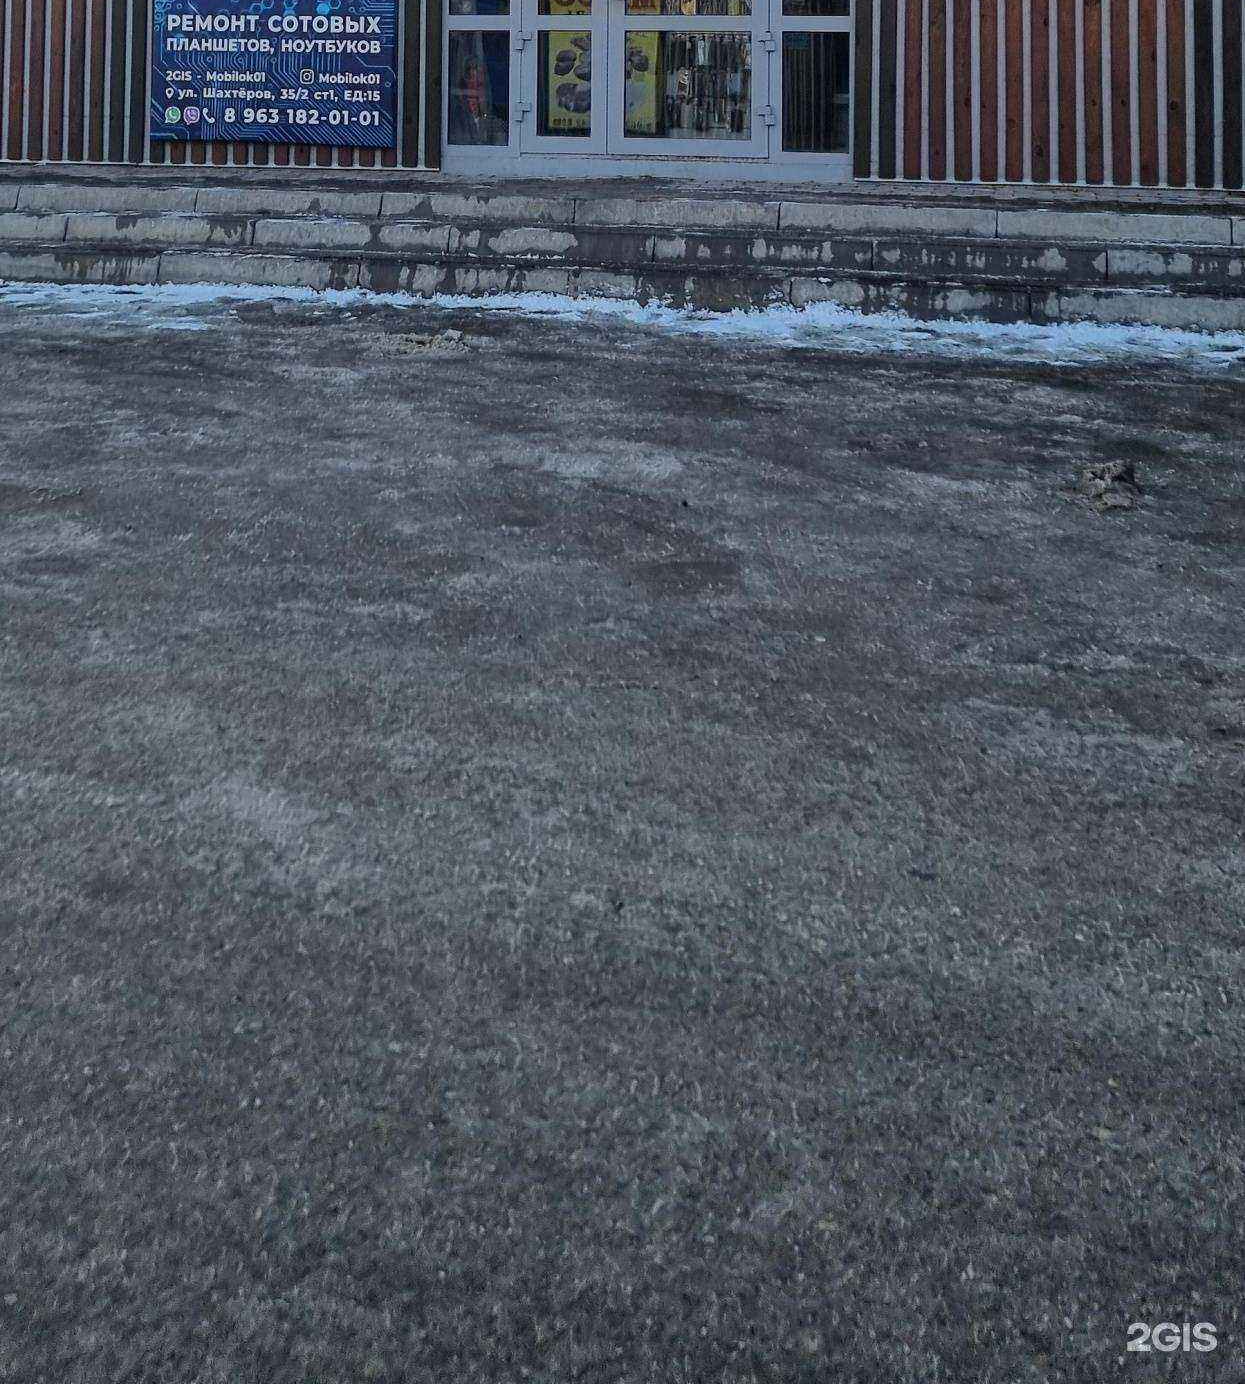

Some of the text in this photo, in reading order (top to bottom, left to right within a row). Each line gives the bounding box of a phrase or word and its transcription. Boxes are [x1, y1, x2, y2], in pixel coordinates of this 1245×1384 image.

[167, 15, 381, 34] РЕМОНТ СОТОВЫХ
[166, 38, 381, 54] ПЛАНШЕТОВ, НОУТБУКОВ
[165, 70, 192, 81] 2GIS
[206, 70, 266, 82] Mobilok01
[319, 73, 381, 84] Mobilok01
[178, 90, 198, 100] ул.
[203, 88, 275, 101] Шахтёров,
[280, 88, 309, 101] 35/2
[345, 90, 381, 103] ЕД:15
[224, 108, 380, 126] 8 963 182-01-01
